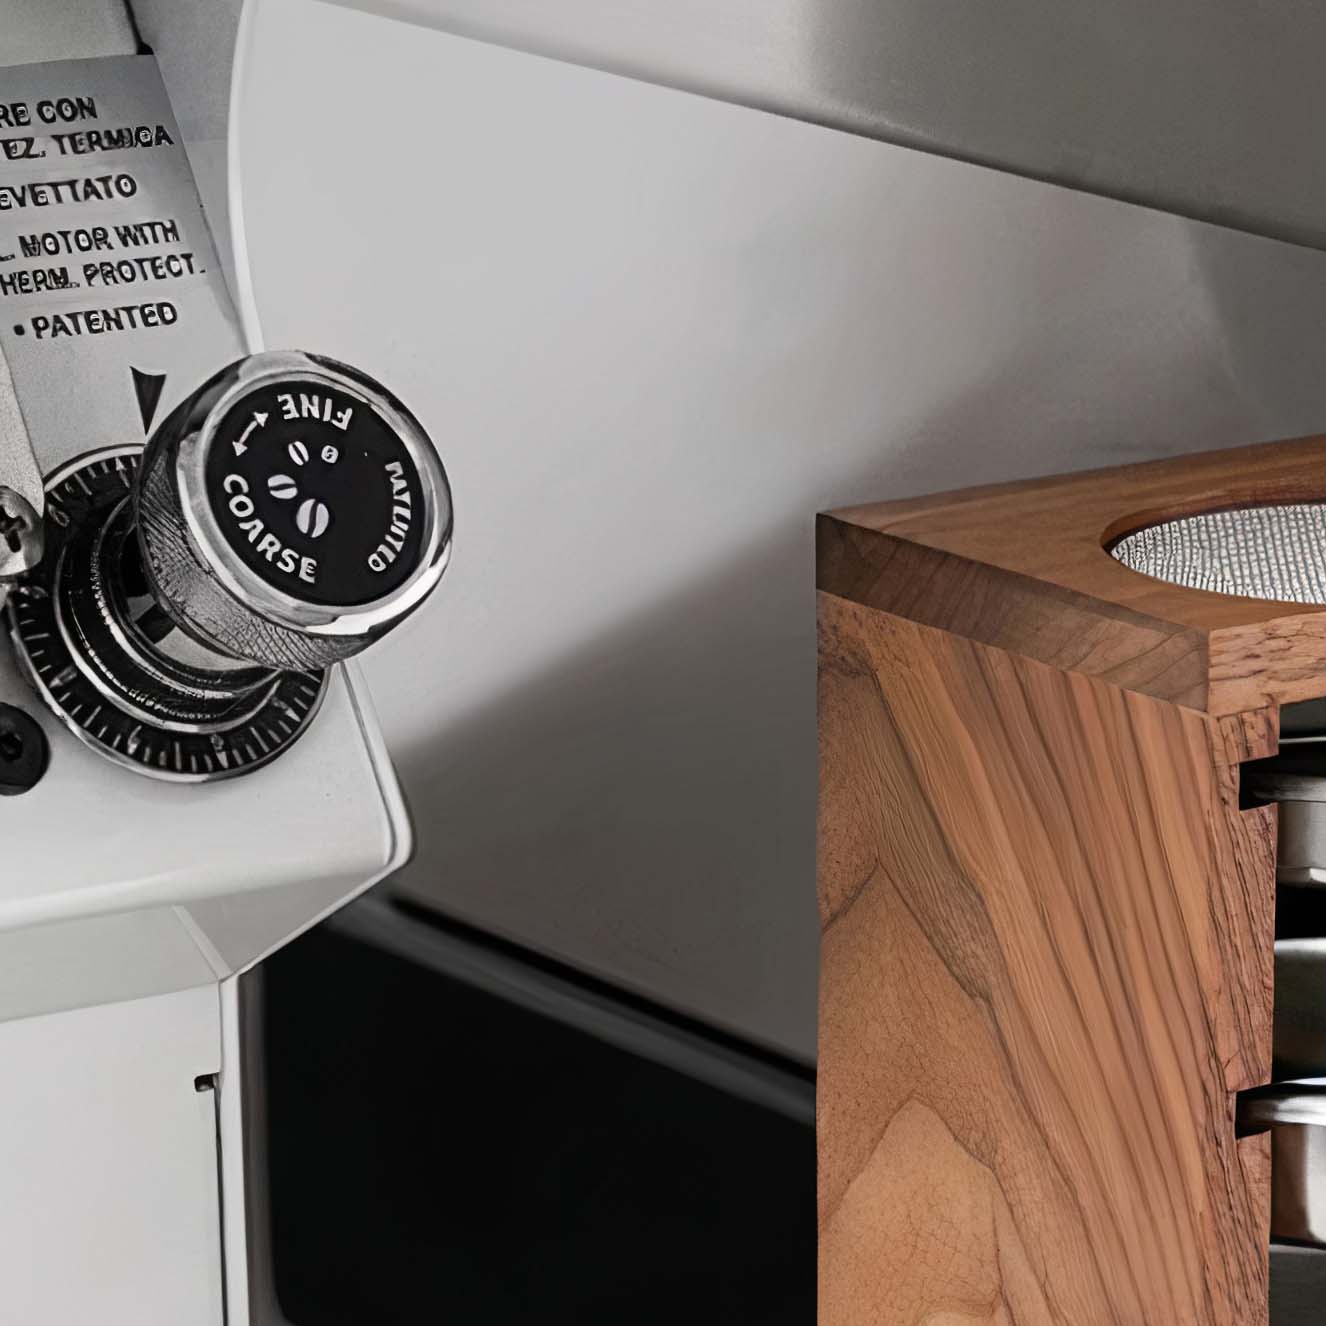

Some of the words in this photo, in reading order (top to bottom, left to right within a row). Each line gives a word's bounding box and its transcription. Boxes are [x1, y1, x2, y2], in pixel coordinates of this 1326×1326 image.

[37, 97, 98, 124] CON
[51, 125, 174, 156] TERMICA
[18, 226, 114, 257] MOTOR
[114, 219, 180, 247] WITH
[83, 253, 206, 286] PROTECT.
[31, 301, 178, 339] PATENTED
[277, 393, 353, 431] FINE
[223, 474, 318, 584] COARSE
